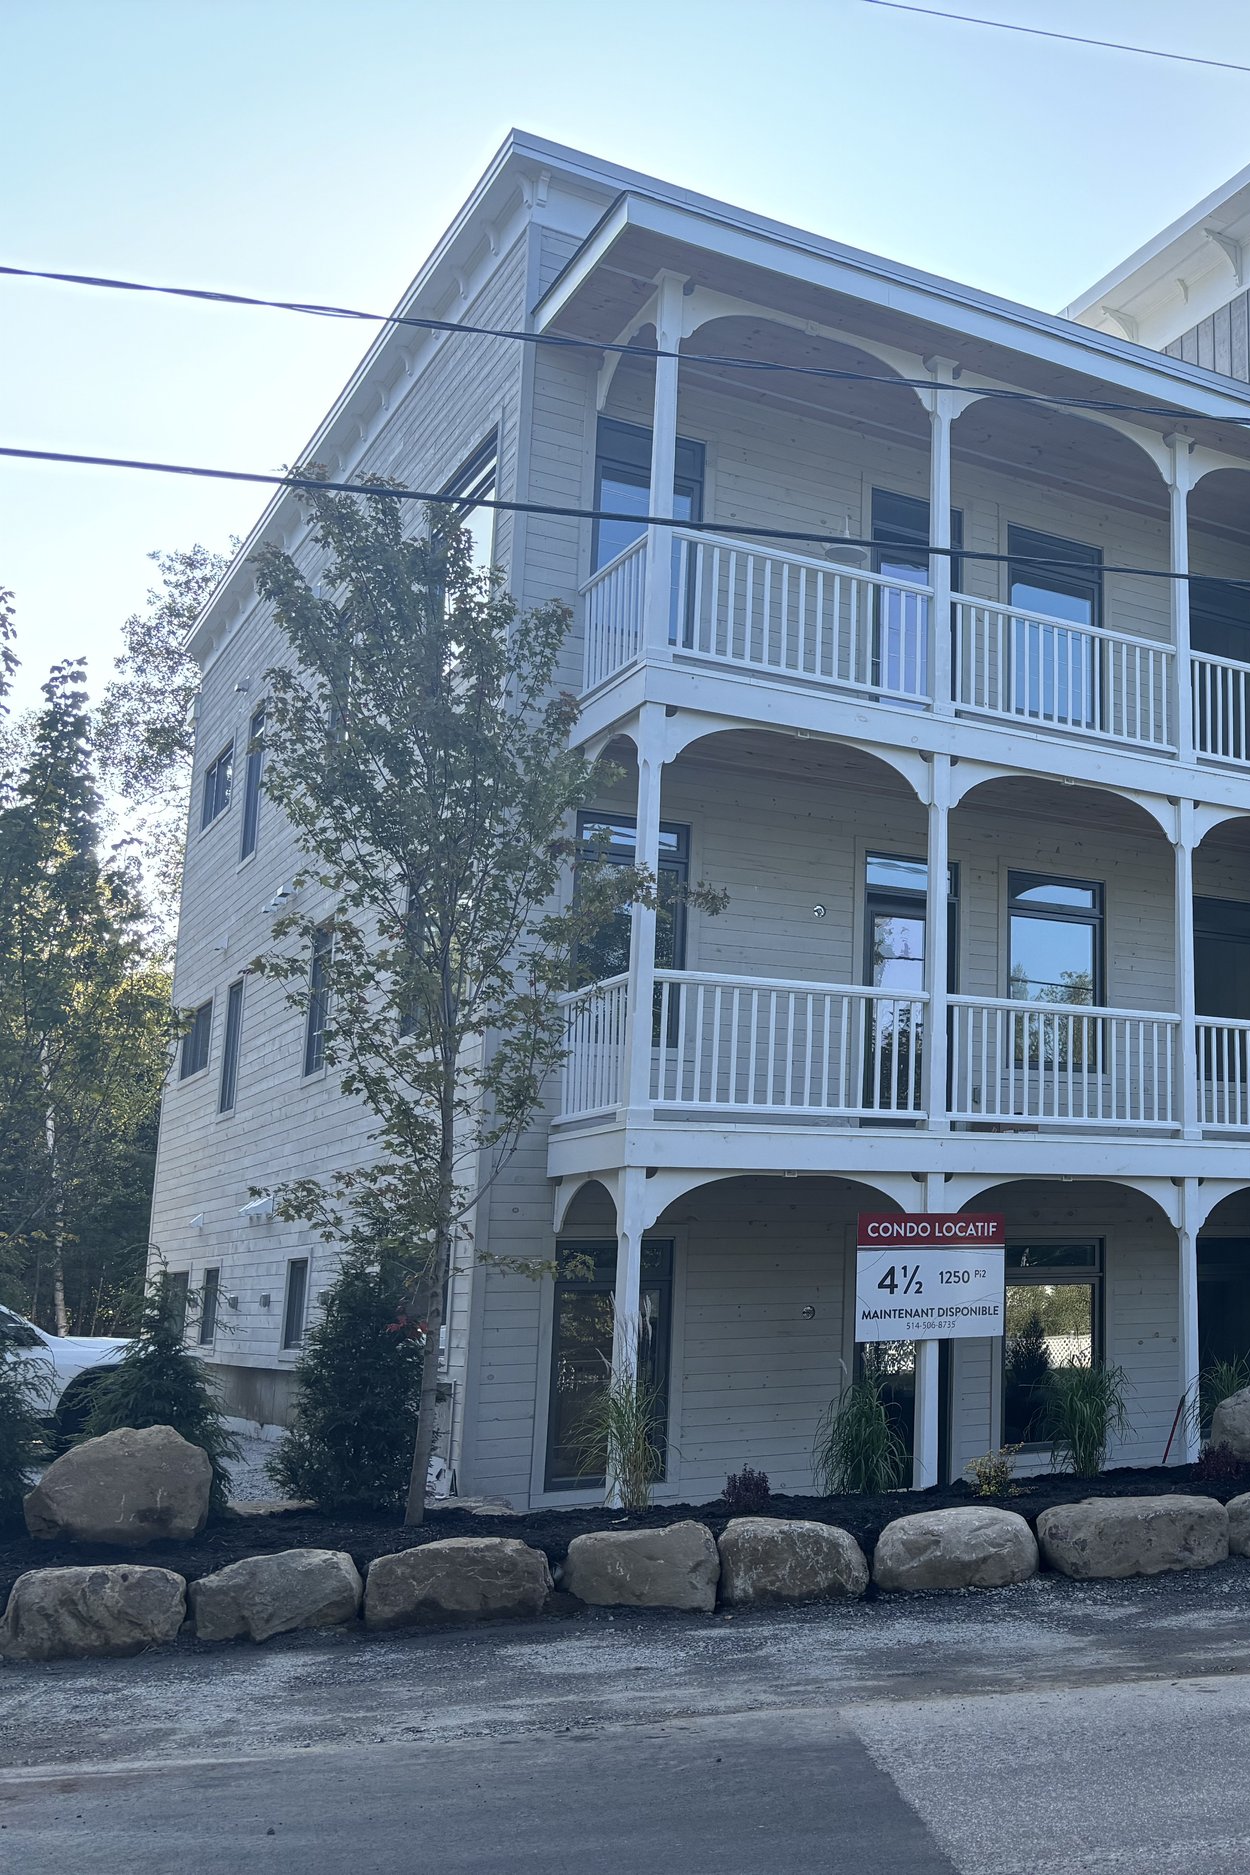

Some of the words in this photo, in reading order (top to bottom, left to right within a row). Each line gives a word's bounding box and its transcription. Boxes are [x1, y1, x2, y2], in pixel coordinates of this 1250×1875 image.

[867, 1223, 931, 1237] CONDO
[935, 1222, 997, 1236] LOCATIF
[939, 1270, 970, 1284] 1250
[861, 1308, 935, 1320] MAINTENANT
[937, 1306, 999, 1317] DISPONIBLE
[906, 1321, 956, 1330] 514-506-8735
